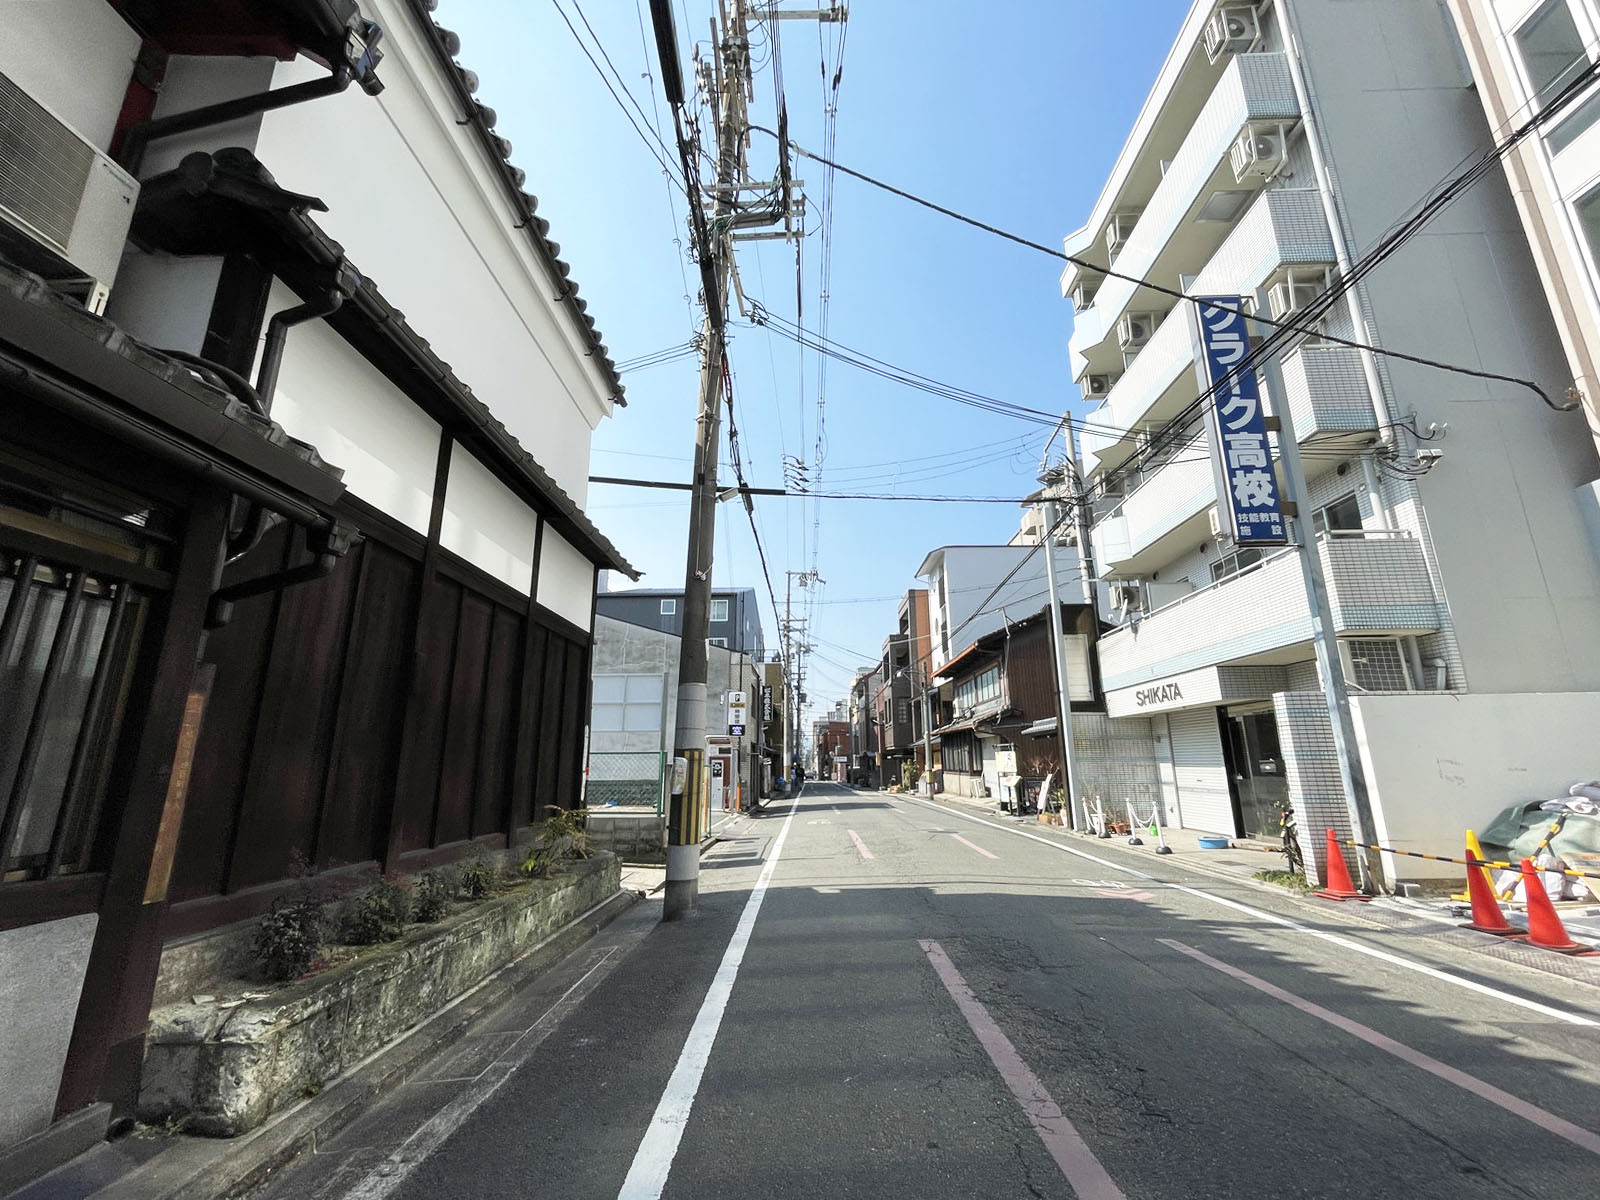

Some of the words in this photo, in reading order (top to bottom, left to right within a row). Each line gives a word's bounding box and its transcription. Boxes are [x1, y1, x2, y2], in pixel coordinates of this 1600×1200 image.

[1203, 300, 1276, 508] クラーク高校
[1237, 512, 1280, 523] 技能教育
[1136, 682, 1184, 707] SHIKATA
